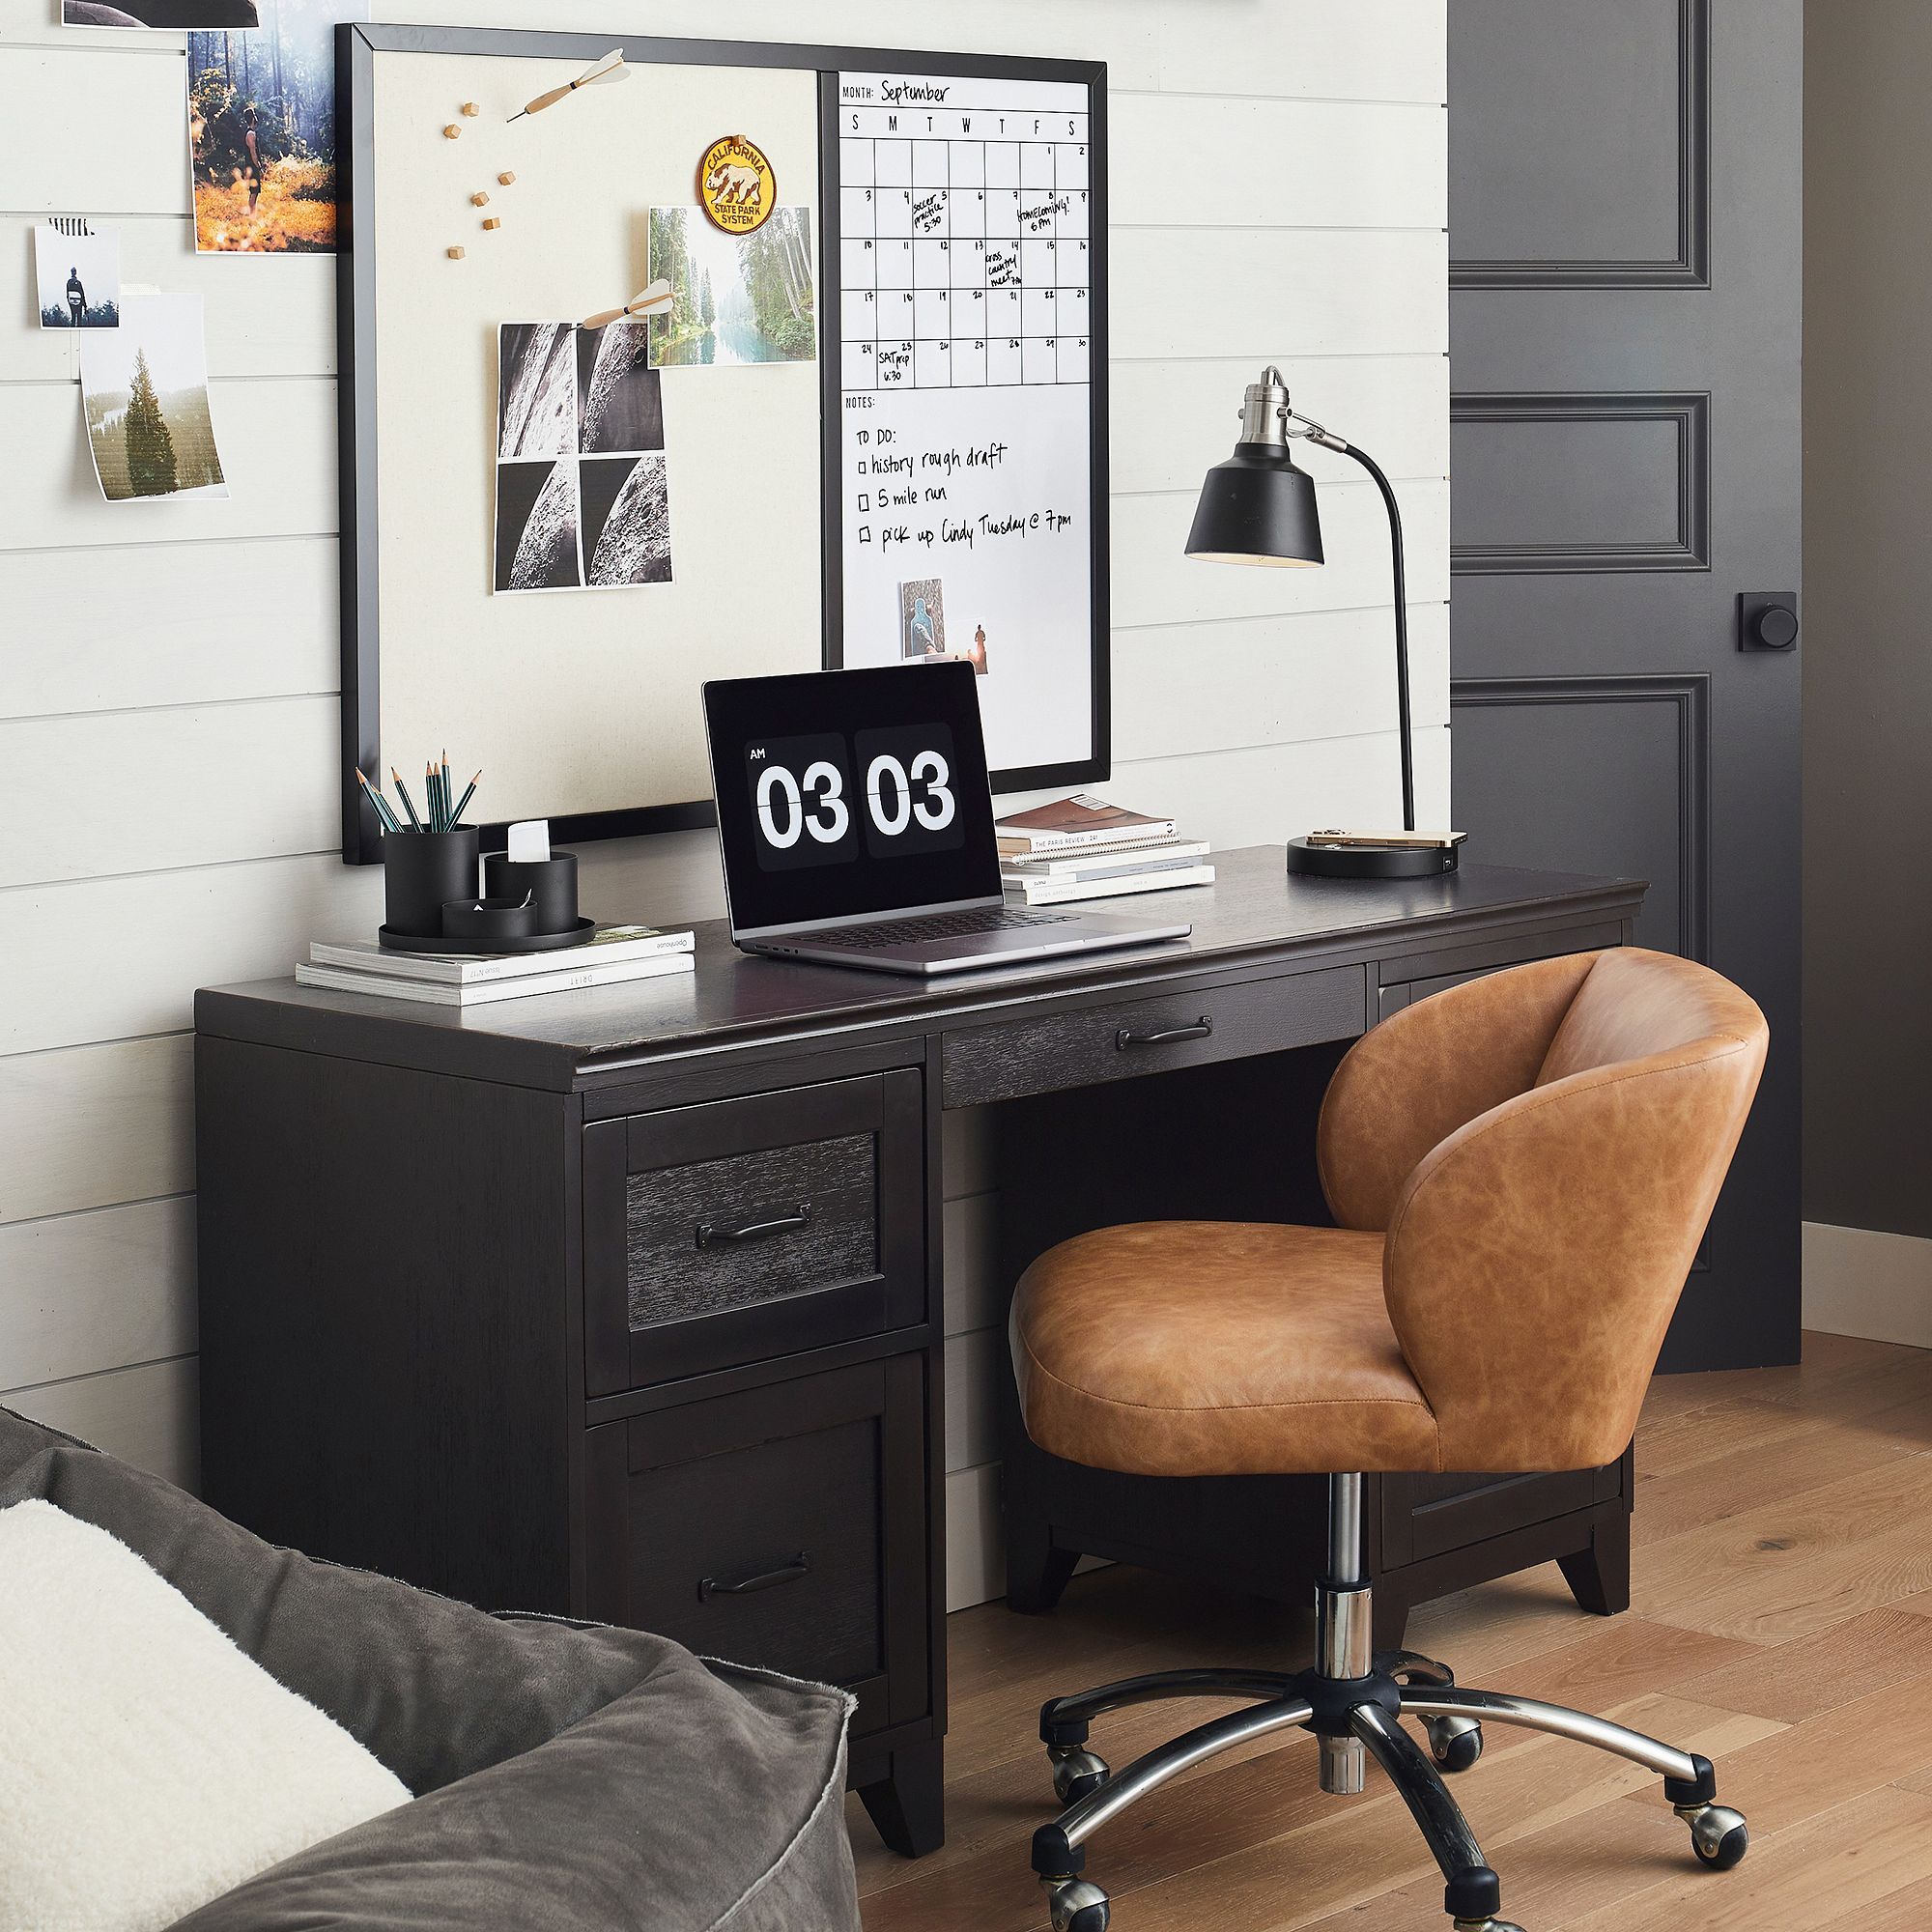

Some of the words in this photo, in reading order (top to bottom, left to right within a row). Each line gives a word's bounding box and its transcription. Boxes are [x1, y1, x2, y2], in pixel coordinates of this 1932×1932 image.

[843, 87, 873, 99] MONTH:
[882, 80, 950, 105] September
[853, 114, 858, 129] S
[890, 116, 896, 130] M
[927, 117, 932, 131] T
[962, 118, 970, 132] W
[1000, 119, 1005, 133] T
[1035, 120, 1039, 134] F
[1069, 121, 1074, 135] S
[708, 145, 766, 174] CALIFORNIA
[866, 190, 871, 201] 3
[904, 191, 909, 205] 4
[942, 190, 947, 200] 5
[1013, 191, 1017, 200] 7
[1081, 192, 1086, 202] 9
[913, 194, 937, 214] soccer
[714, 204, 737, 214] STATE
[738, 206, 761, 215] PARK
[914, 203, 944, 228] practice
[722, 214, 754, 225] SYSTEM
[924, 216, 941, 233] 5:30
[1031, 222, 1037, 231] 6
[865, 241, 872, 249] 10
[941, 242, 948, 250] 12
[976, 241, 983, 250] 13
[1012, 242, 1018, 250] 14
[1080, 242, 1086, 250] 16
[986, 251, 1002, 262] cross
[991, 270, 1012, 287] meet
[866, 292, 873, 301] 17
[904, 294, 912, 302] 18
[940, 292, 946, 300] 19
[973, 291, 982, 299] 20
[862, 345, 871, 354] 24
[902, 342, 912, 351] 25
[879, 351, 898, 364] SAT
[896, 355, 909, 370] prep
[884, 371, 901, 382] 6:30
[846, 397, 874, 408] NOTES:
[857, 431, 868, 445] TO
[877, 429, 895, 445] DO:
[872, 454, 913, 477] history
[923, 448, 961, 476] rough
[967, 442, 1008, 469] draft
[879, 489, 889, 507] 5
[894, 486, 917, 505] mile
[925, 487, 947, 501] run
[883, 526, 910, 553] pick
[918, 530, 934, 548] up
[942, 519, 973, 550] Cindy
[979, 514, 1025, 538] Tuesday
[1030, 513, 1038, 528] @
[750, 748, 766, 759] AM
[756, 761, 849, 849] 03
[867, 750, 955, 837] 03
[656, 939, 687, 950] Openhouse
